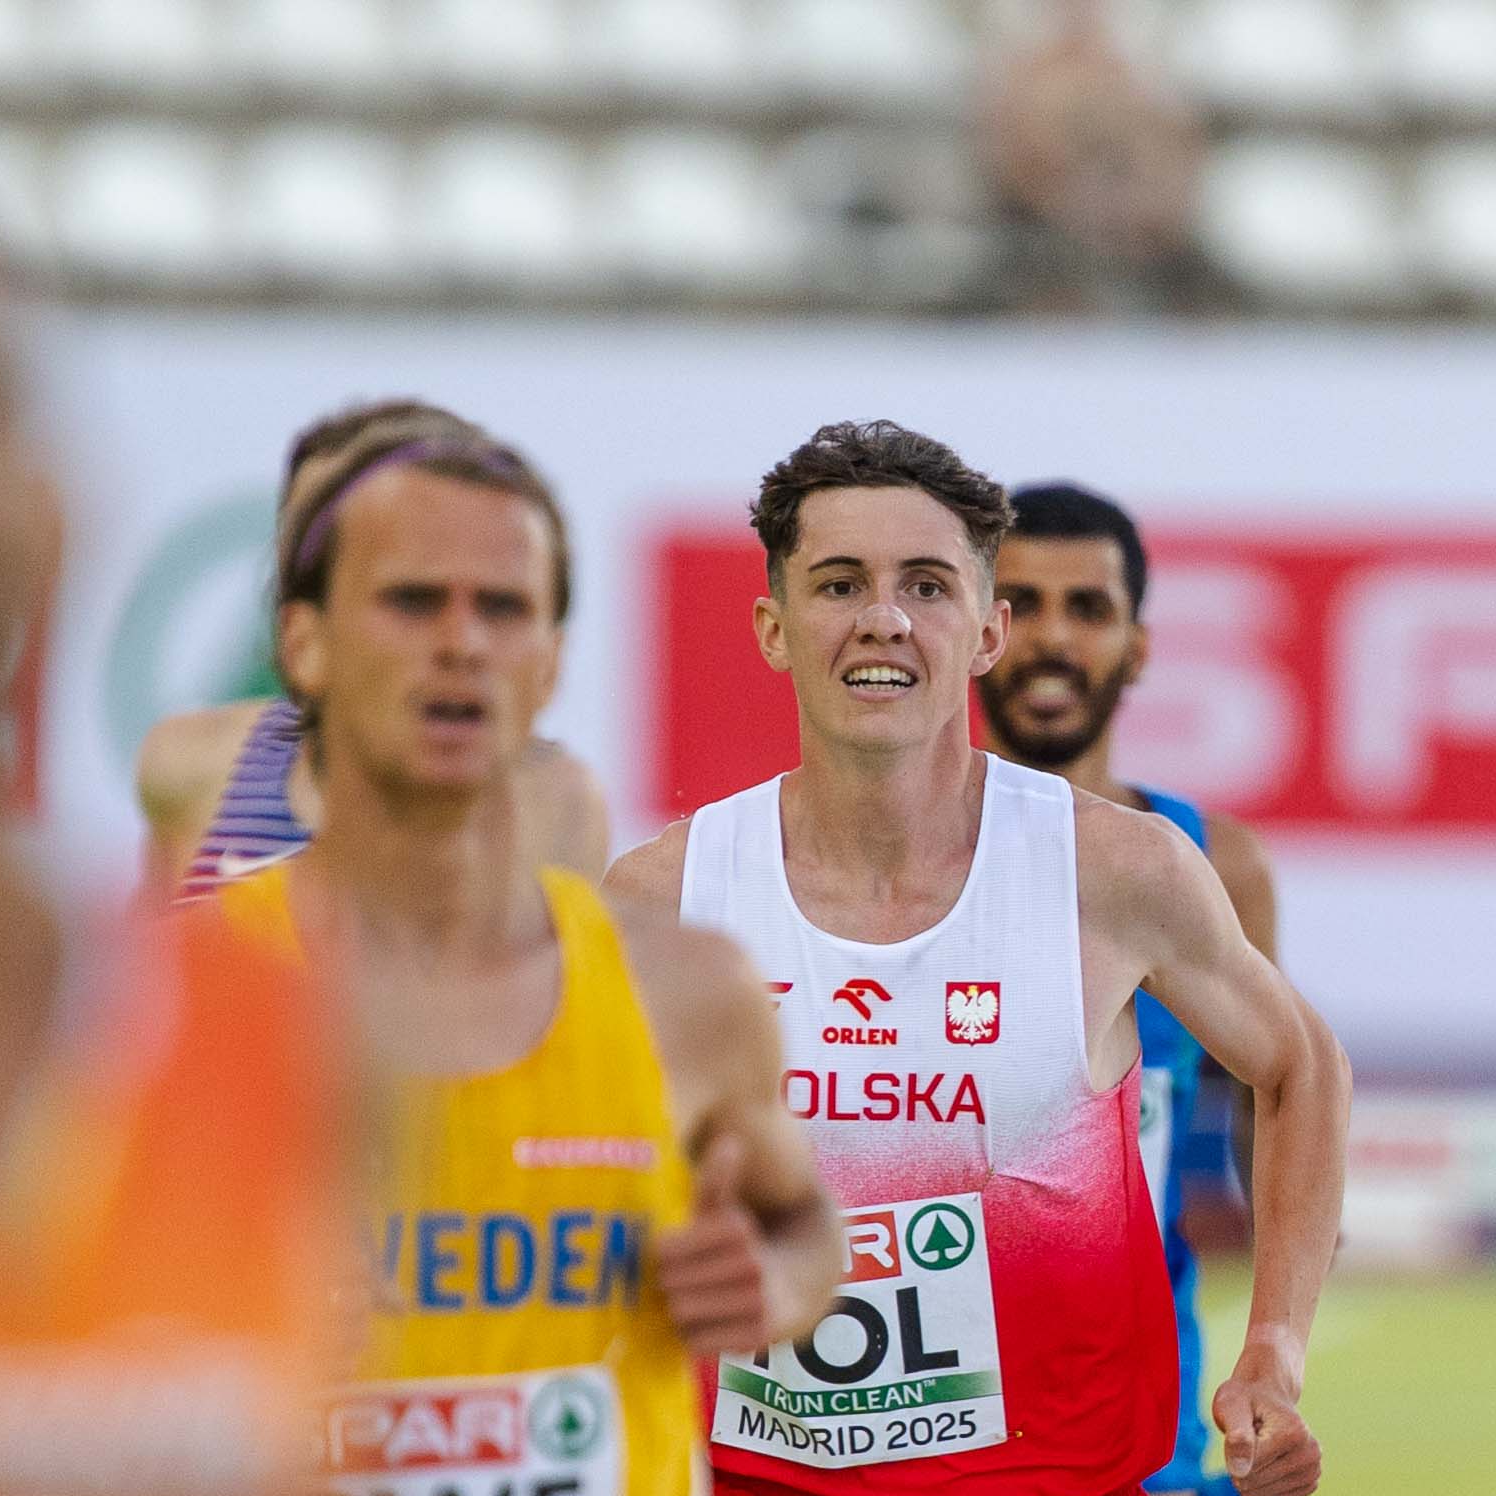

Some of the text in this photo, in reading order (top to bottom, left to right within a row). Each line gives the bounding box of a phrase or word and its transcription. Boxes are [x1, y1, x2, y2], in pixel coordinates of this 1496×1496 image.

[822, 1027, 897, 1045] ORLEN
[780, 1069, 986, 1125] OLSKA
[360, 1211, 650, 1311] EDEN
[753, 1286, 961, 1385] OL
[775, 1388, 824, 1415] RUN
[323, 1398, 515, 1467] PAR
[738, 1405, 977, 1456] MADRID 2025
